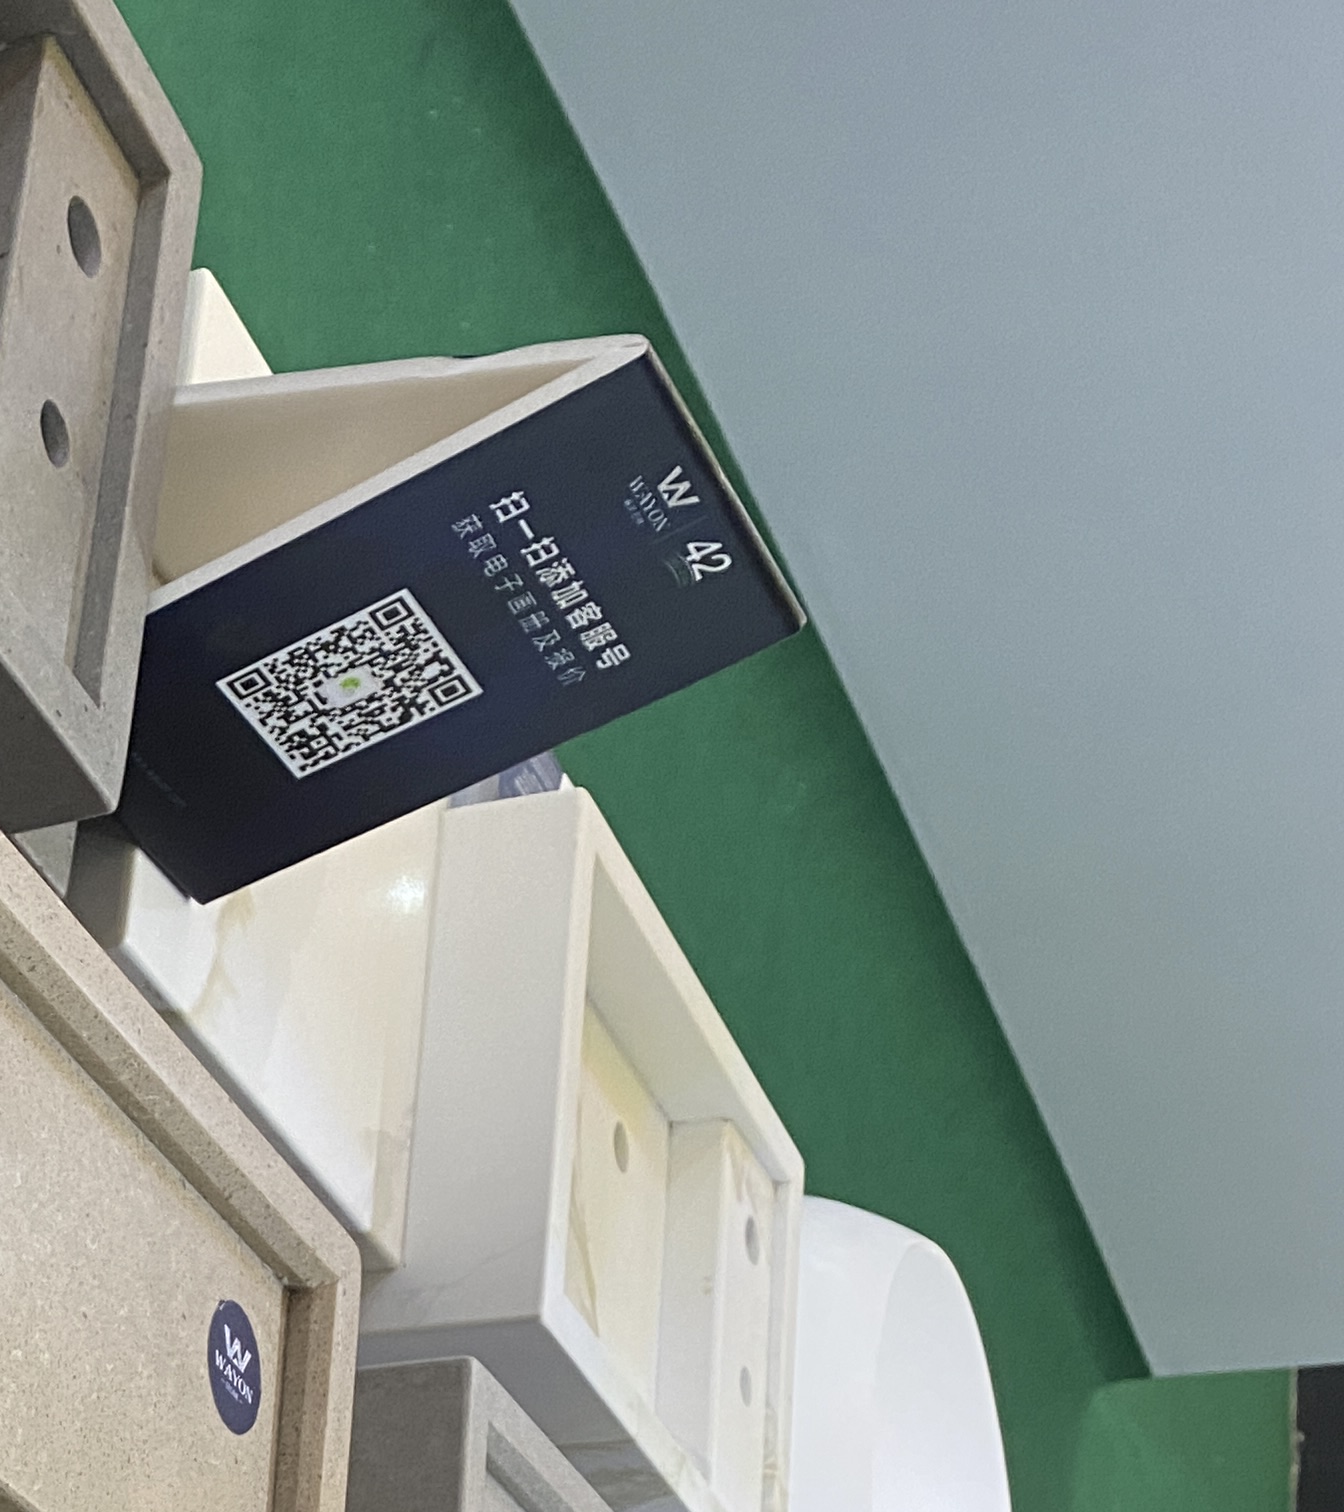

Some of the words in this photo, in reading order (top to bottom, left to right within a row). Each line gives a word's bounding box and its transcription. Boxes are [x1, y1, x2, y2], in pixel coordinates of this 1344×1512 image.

[629, 475, 672, 531] WAYON
[490, 491, 632, 669] 扫一扫添加客服号
[686, 540, 732, 581] 42
[451, 514, 587, 687] 获取电子画册及报价
[215, 1350, 254, 1404] WAYON
